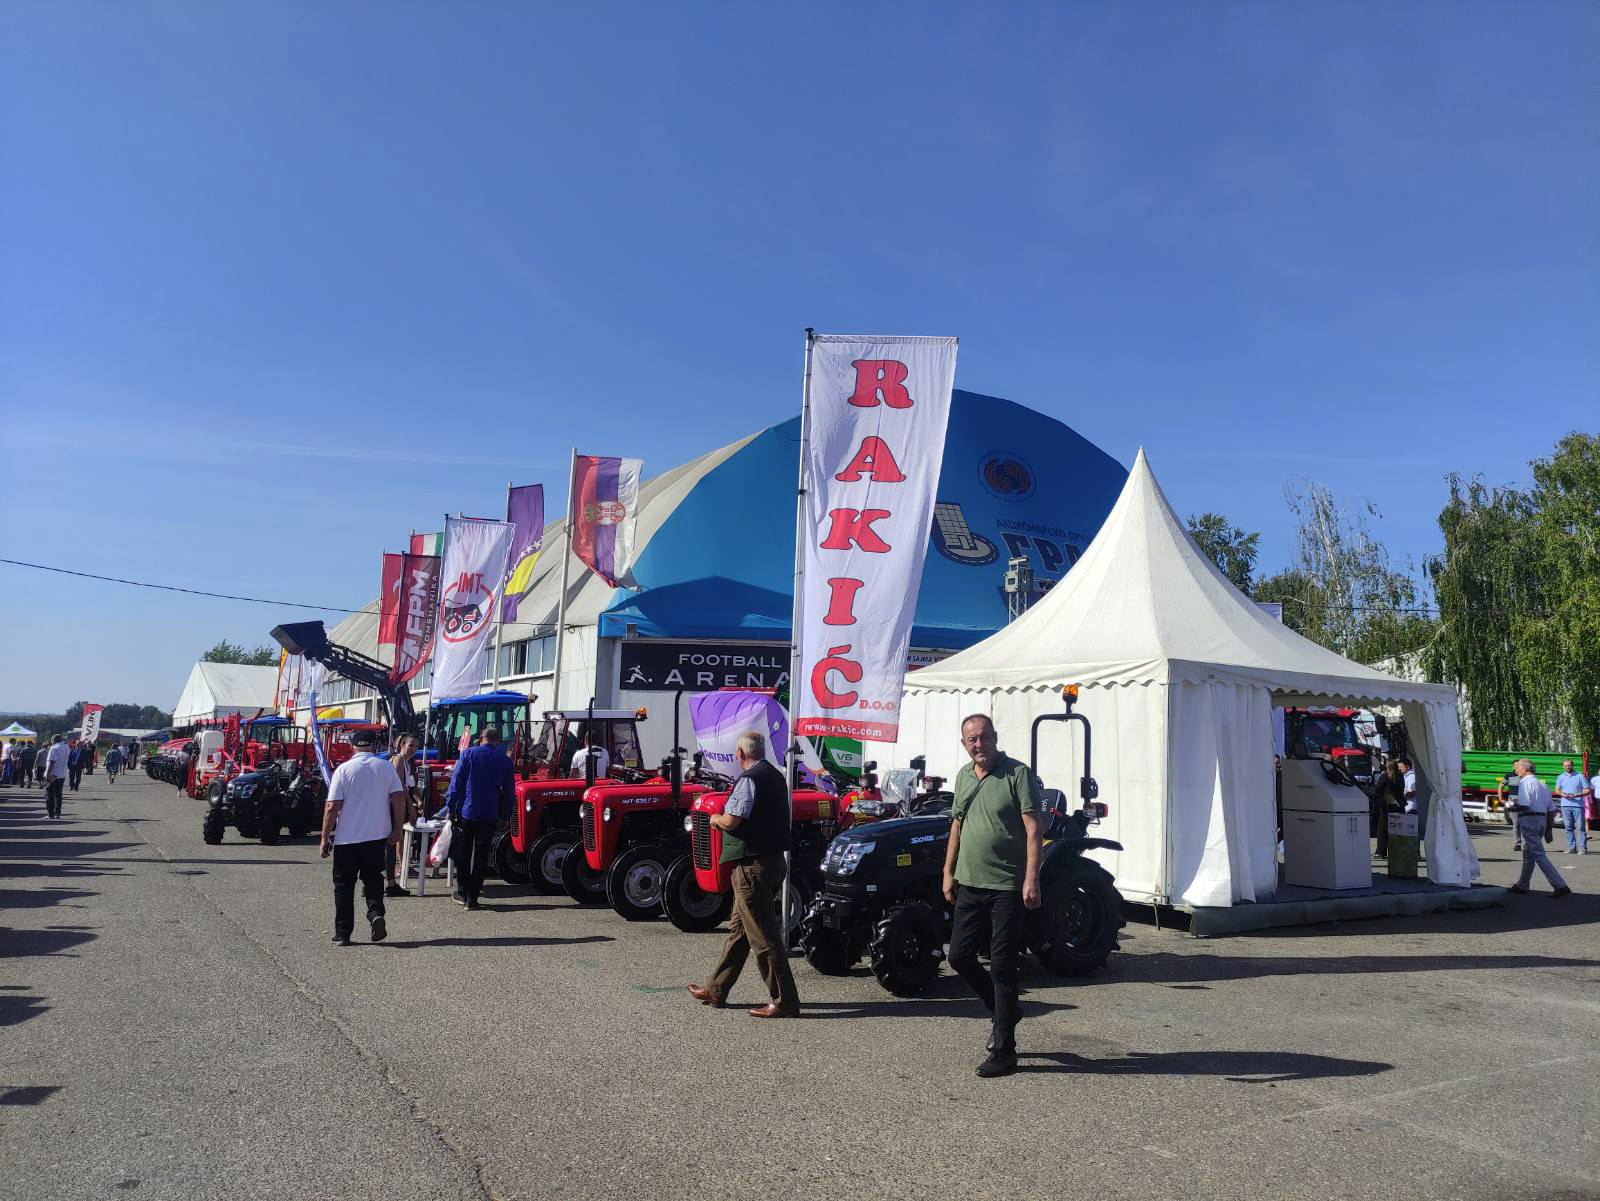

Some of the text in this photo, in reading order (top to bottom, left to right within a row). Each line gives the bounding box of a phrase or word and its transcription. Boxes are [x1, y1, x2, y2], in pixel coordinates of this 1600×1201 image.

[811, 358, 914, 710] RAKIĆ
[457, 572, 485, 594] IMT
[678, 653, 783, 668] FOOTBALL
[663, 668, 790, 687] ARENA
